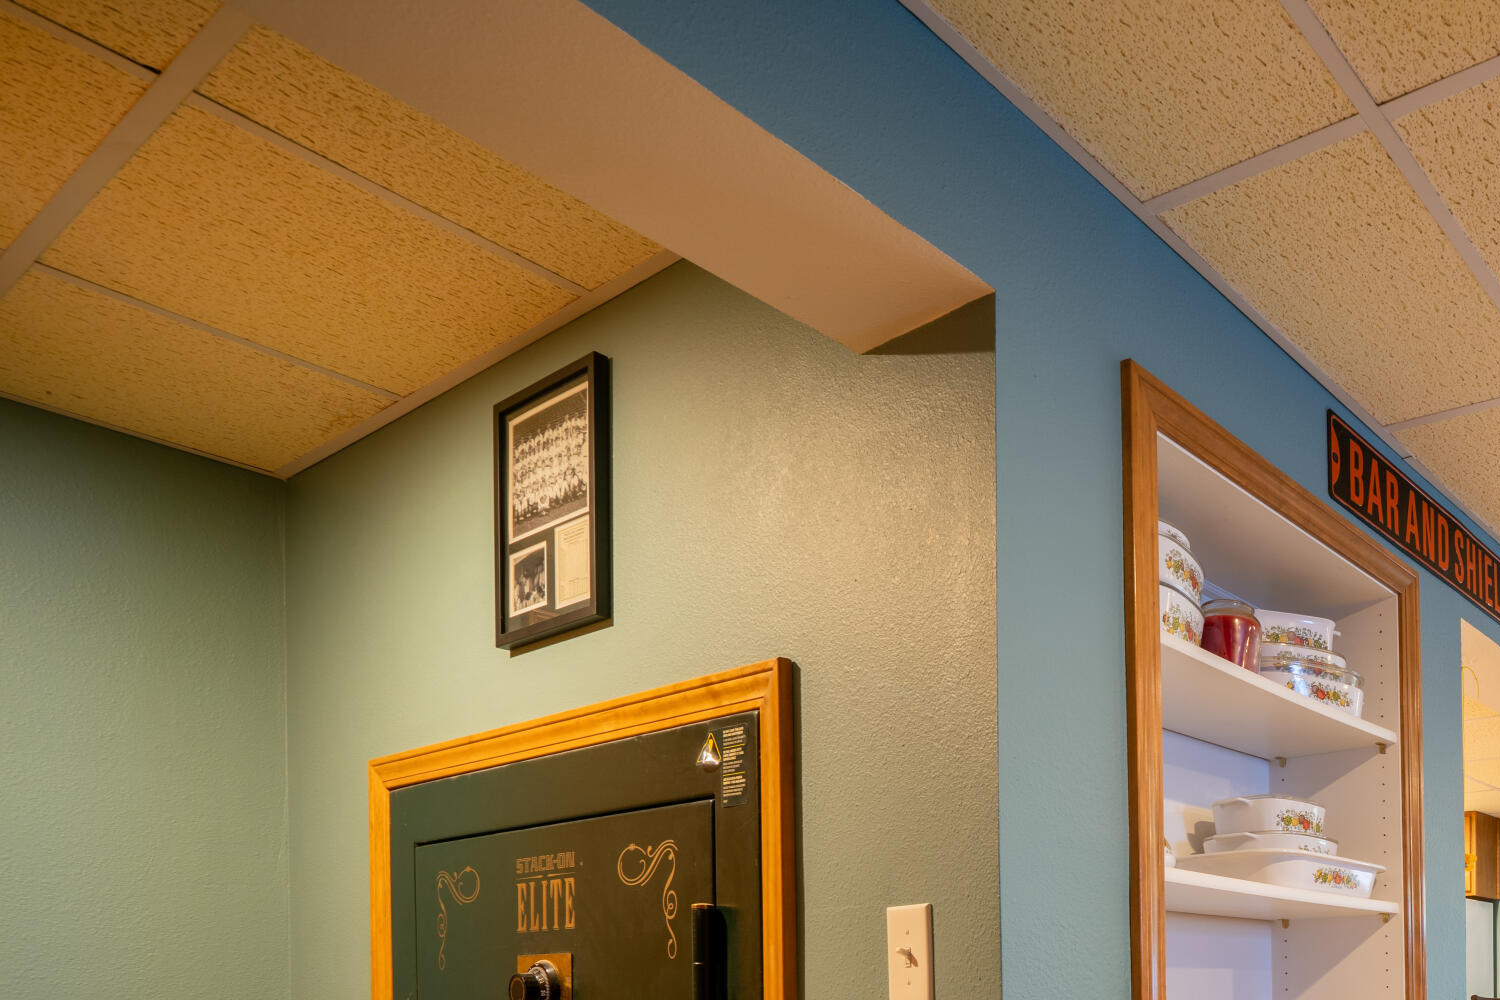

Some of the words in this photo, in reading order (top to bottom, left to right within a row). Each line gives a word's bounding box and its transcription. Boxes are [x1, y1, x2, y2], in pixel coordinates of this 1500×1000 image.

[1350, 438, 1400, 537] BAR
[1405, 490, 1449, 572] AND
[516, 851, 576, 874] STACK-ON
[516, 877, 576, 933] ELITE
